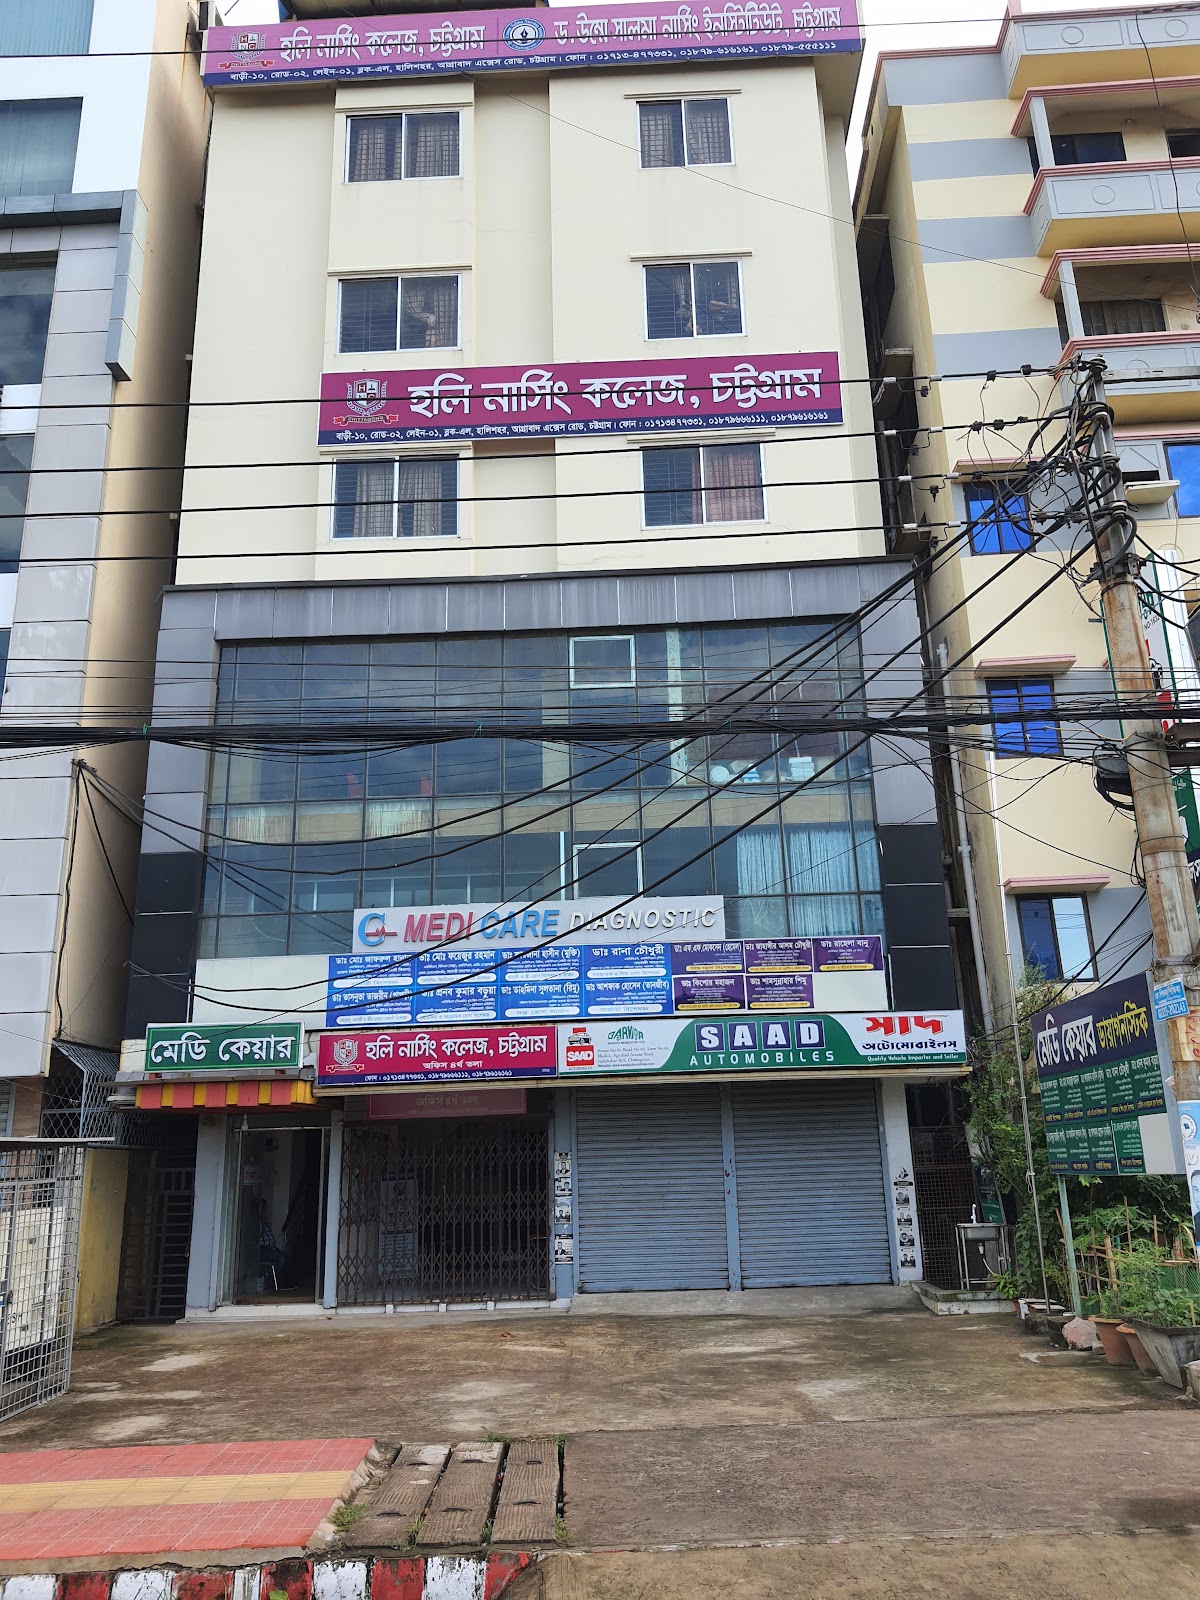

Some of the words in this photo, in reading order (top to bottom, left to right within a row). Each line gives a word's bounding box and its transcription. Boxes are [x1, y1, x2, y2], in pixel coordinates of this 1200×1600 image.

[611, 15, 657, 42] সালমা
[661, 4, 701, 42] নার্সিং
[792, 1, 842, 38] চট্টগ্রাম
[279, 26, 313, 63] হলি
[316, 23, 361, 61] নার্সিং
[365, 29, 424, 57] কলেজ,
[429, 21, 486, 57] চট্টগ্রাম
[565, 54, 586, 62] ফোন
[407, 372, 473, 419] হলি
[480, 368, 572, 415] নার্সিং
[579, 374, 701, 410] কলেজ,
[709, 363, 823, 409] চট্টগ্রাম
[370, 429, 404, 440] রোড-০২,
[405, 427, 442, 438] লেইন-০১,
[476, 423, 509, 436] হালিশহর,
[511, 422, 541, 434] আগ্রাবাদ
[542, 421, 566, 432] এক্সেস
[567, 420, 587, 432] রোড,
[618, 418, 637, 429] ফোন
[403, 911, 474, 943] MEDI
[480, 909, 561, 939] CARE
[569, 907, 716, 932] DIAGNOSTIC
[474, 950, 495, 960] রহমান
[591, 947, 609, 957] ডাঃ
[611, 946, 632, 956] রানা
[634, 944, 665, 957] চৌধুরী
[455, 986, 475, 998] কুমার
[700, 1022, 820, 1048] SAAD
[863, 1014, 949, 1037] সাদ
[151, 1031, 211, 1064] মেডি
[218, 1033, 297, 1062] কেয়ার
[364, 1034, 394, 1060] হলি
[397, 1033, 438, 1059] নার্সিং
[441, 1037, 494, 1058] কলেজ,
[497, 1032, 548, 1057] চট্টগ্রাম
[1037, 1013, 1060, 1068] মেডি
[1061, 1014, 1097, 1063] কেয়ার
[422, 1060, 448, 1071] অফিস
[450, 1058, 464, 1069] ৪র্থ
[465, 1059, 484, 1068] তলা
[689, 1050, 835, 1067] AUTOMOBILES
[867, 1054, 889, 1063] Quality
[889, 1053, 907, 1061] Vehicle
[908, 1053, 932, 1062] Importer
[944, 1052, 959, 1060] Seller
